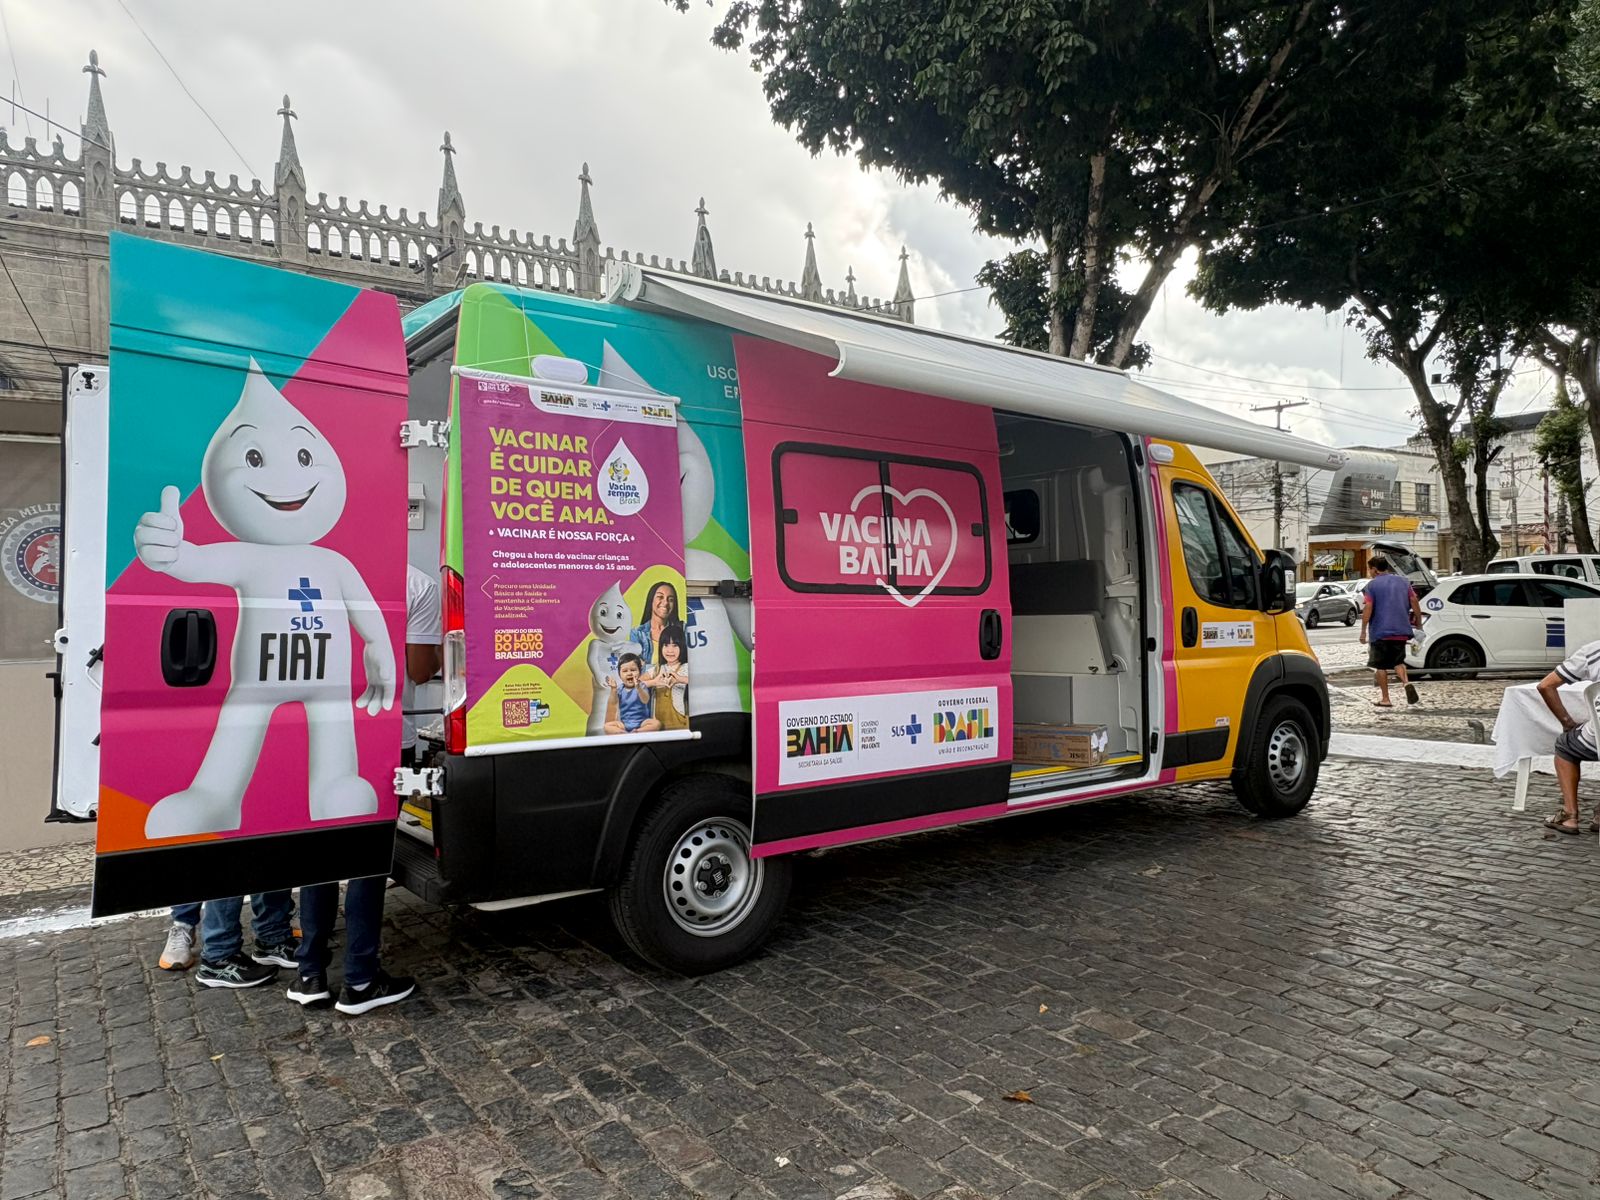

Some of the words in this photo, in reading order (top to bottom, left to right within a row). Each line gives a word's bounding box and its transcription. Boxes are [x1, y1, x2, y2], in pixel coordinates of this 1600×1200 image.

[489, 427, 588, 453] VACINAR
[490, 446, 504, 470] É
[508, 454, 592, 477] CUIDAR
[490, 476, 522, 496] DE
[526, 479, 592, 500] QUEM
[608, 490, 640, 498] sempre
[609, 482, 637, 491] Vacina
[491, 499, 554, 522] VOCÊ
[558, 506, 615, 525] AMA.
[497, 528, 547, 540] VACINAR
[549, 527, 556, 540] É
[557, 530, 593, 541] NOSSA
[594, 532, 630, 544] FORÇA
[819, 512, 932, 546] VACINA
[492, 550, 526, 560] Chegou
[534, 552, 554, 560] hora
[554, 552, 566, 560] de
[597, 554, 629, 562] crianças
[839, 541, 933, 576] BAHIA
[500, 561, 557, 570] adolescentes
[558, 563, 593, 571] menores
[594, 563, 605, 571] de
[1428, 600, 1442, 609] 04
[290, 616, 324, 631] SUS
[495, 633, 512, 642] DO
[513, 633, 543, 642] LADO
[495, 643, 512, 652] DO
[513, 642, 544, 651] POVO
[259, 633, 332, 681] FIAT
[495, 651, 544, 660] BRASILEIRO
[938, 698, 964, 707] GOVERNO
[965, 696, 989, 705] FEDERAL
[786, 716, 818, 727] GOVERNO
[819, 715, 829, 725] DO
[830, 712, 853, 724] ESTADO
[933, 708, 994, 743] BRASIL
[891, 725, 905, 737] SUS
[786, 724, 853, 758] BAHIA
